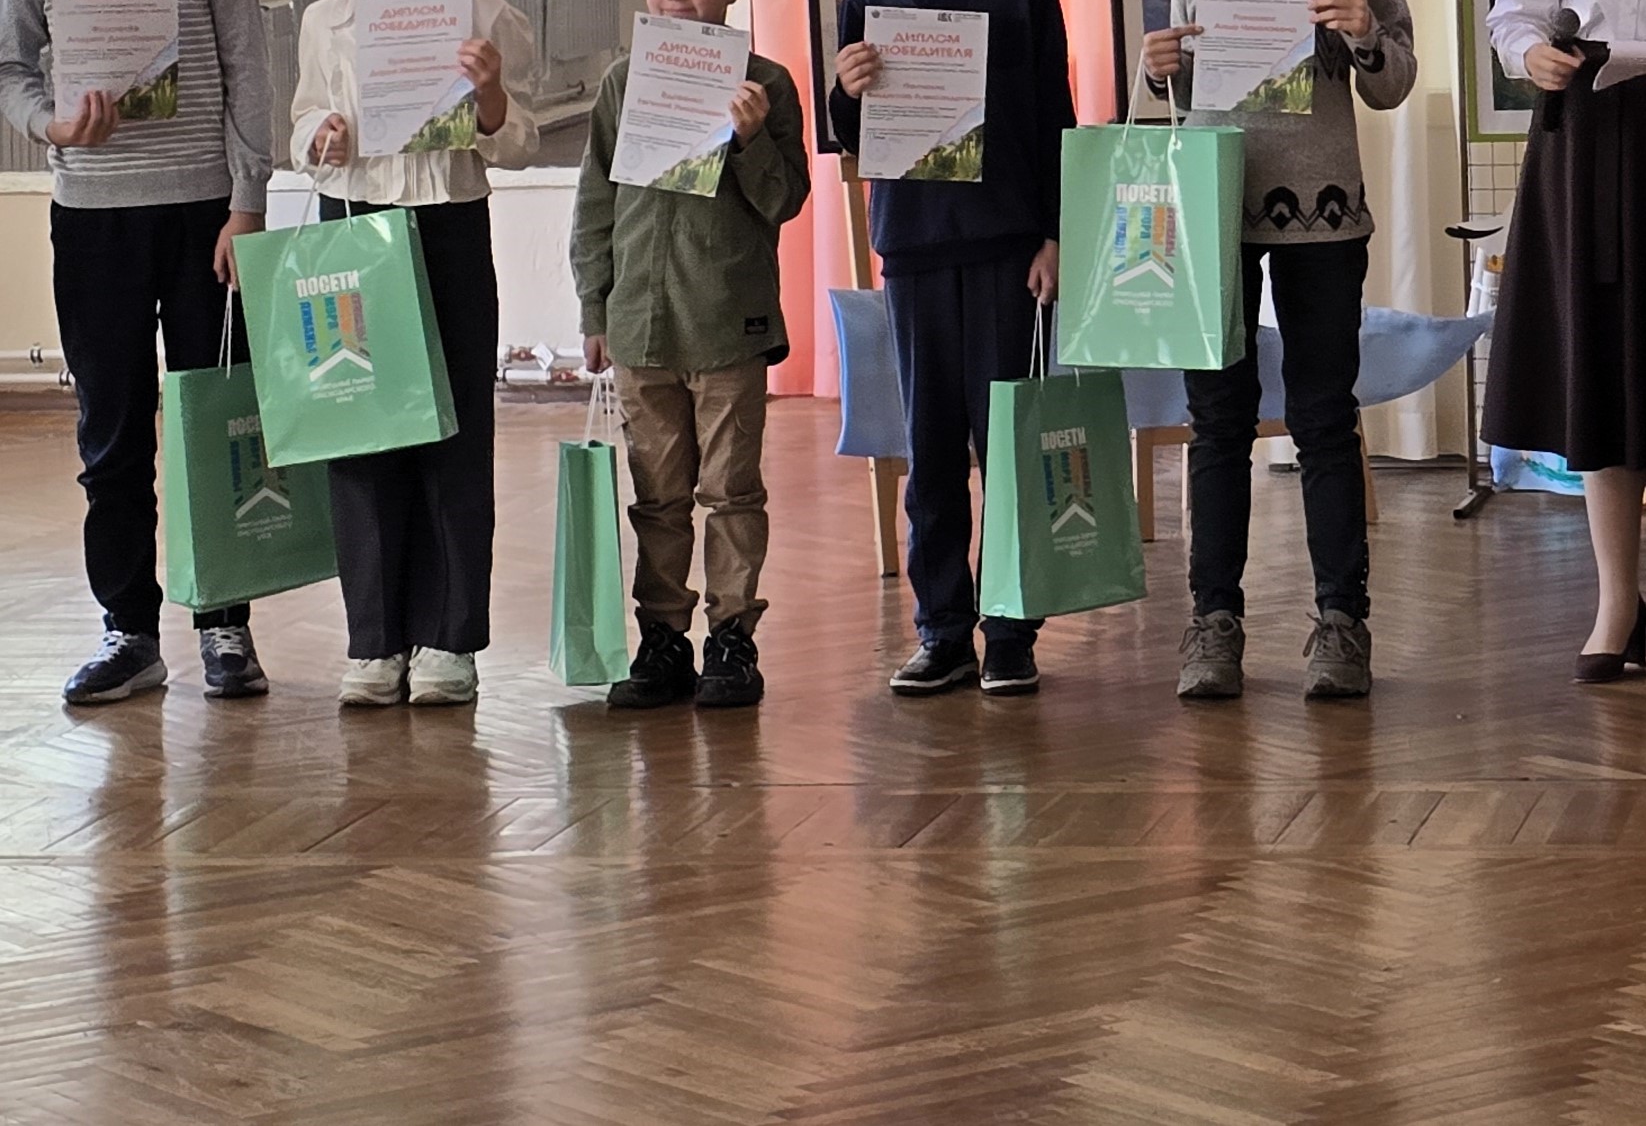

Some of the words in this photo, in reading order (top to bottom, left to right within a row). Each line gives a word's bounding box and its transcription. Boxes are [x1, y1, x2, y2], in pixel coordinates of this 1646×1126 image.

[380, 4, 445, 20] ДИПЛОМ
[368, 17, 458, 32] ПОБЕДИТЕЛЯ
[893, 32, 961, 44] ДИПЛОМ
[658, 41, 722, 59] ДИПЛОМ
[879, 44, 974, 59] ПОБЕДИТЕЛЯ
[645, 51, 732, 74] ПОБЕДИТЕЛЯ
[1116, 183, 1177, 203] ПОСЕТИ
[296, 269, 360, 298] ПОСЕТИ
[1040, 426, 1087, 450] ПОСЕТИ
